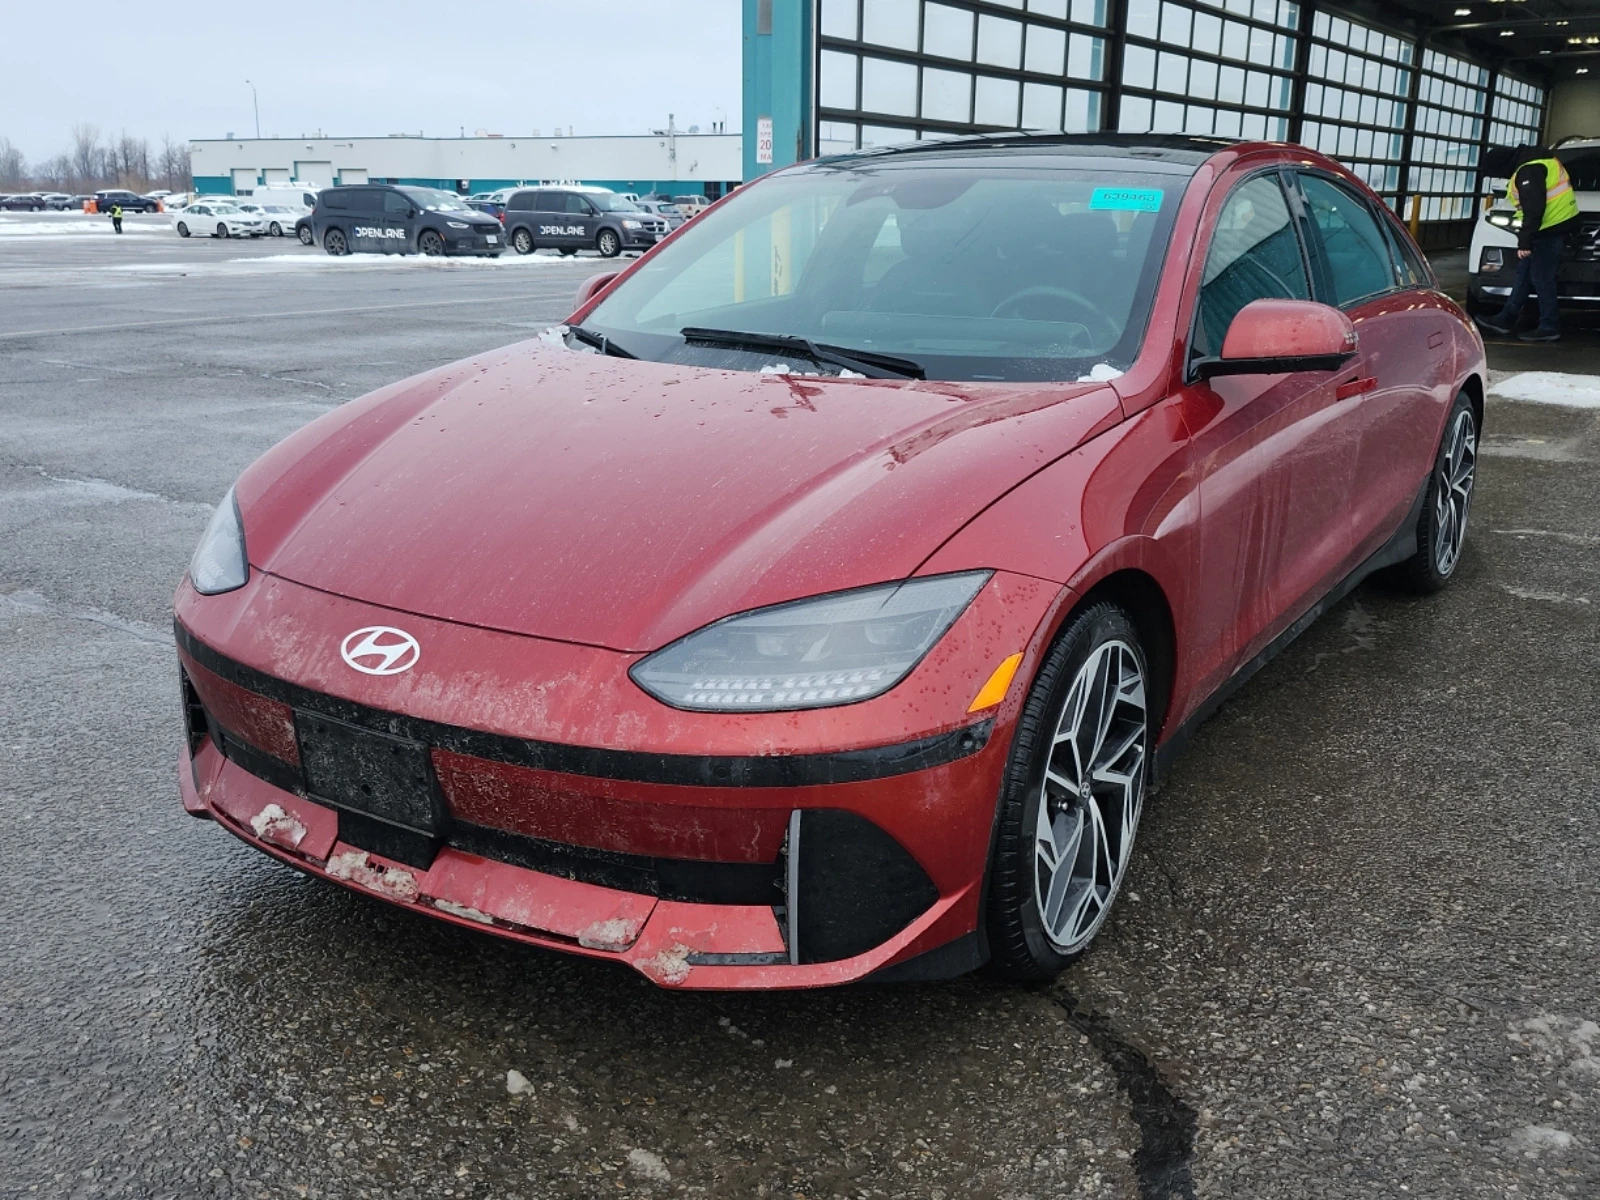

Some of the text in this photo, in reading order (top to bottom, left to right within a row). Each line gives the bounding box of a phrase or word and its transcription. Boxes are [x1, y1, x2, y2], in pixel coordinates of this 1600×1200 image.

[760, 139, 772, 150] 20
[353, 226, 406, 239] OPENLANE
[538, 225, 585, 236] OPENLANE
